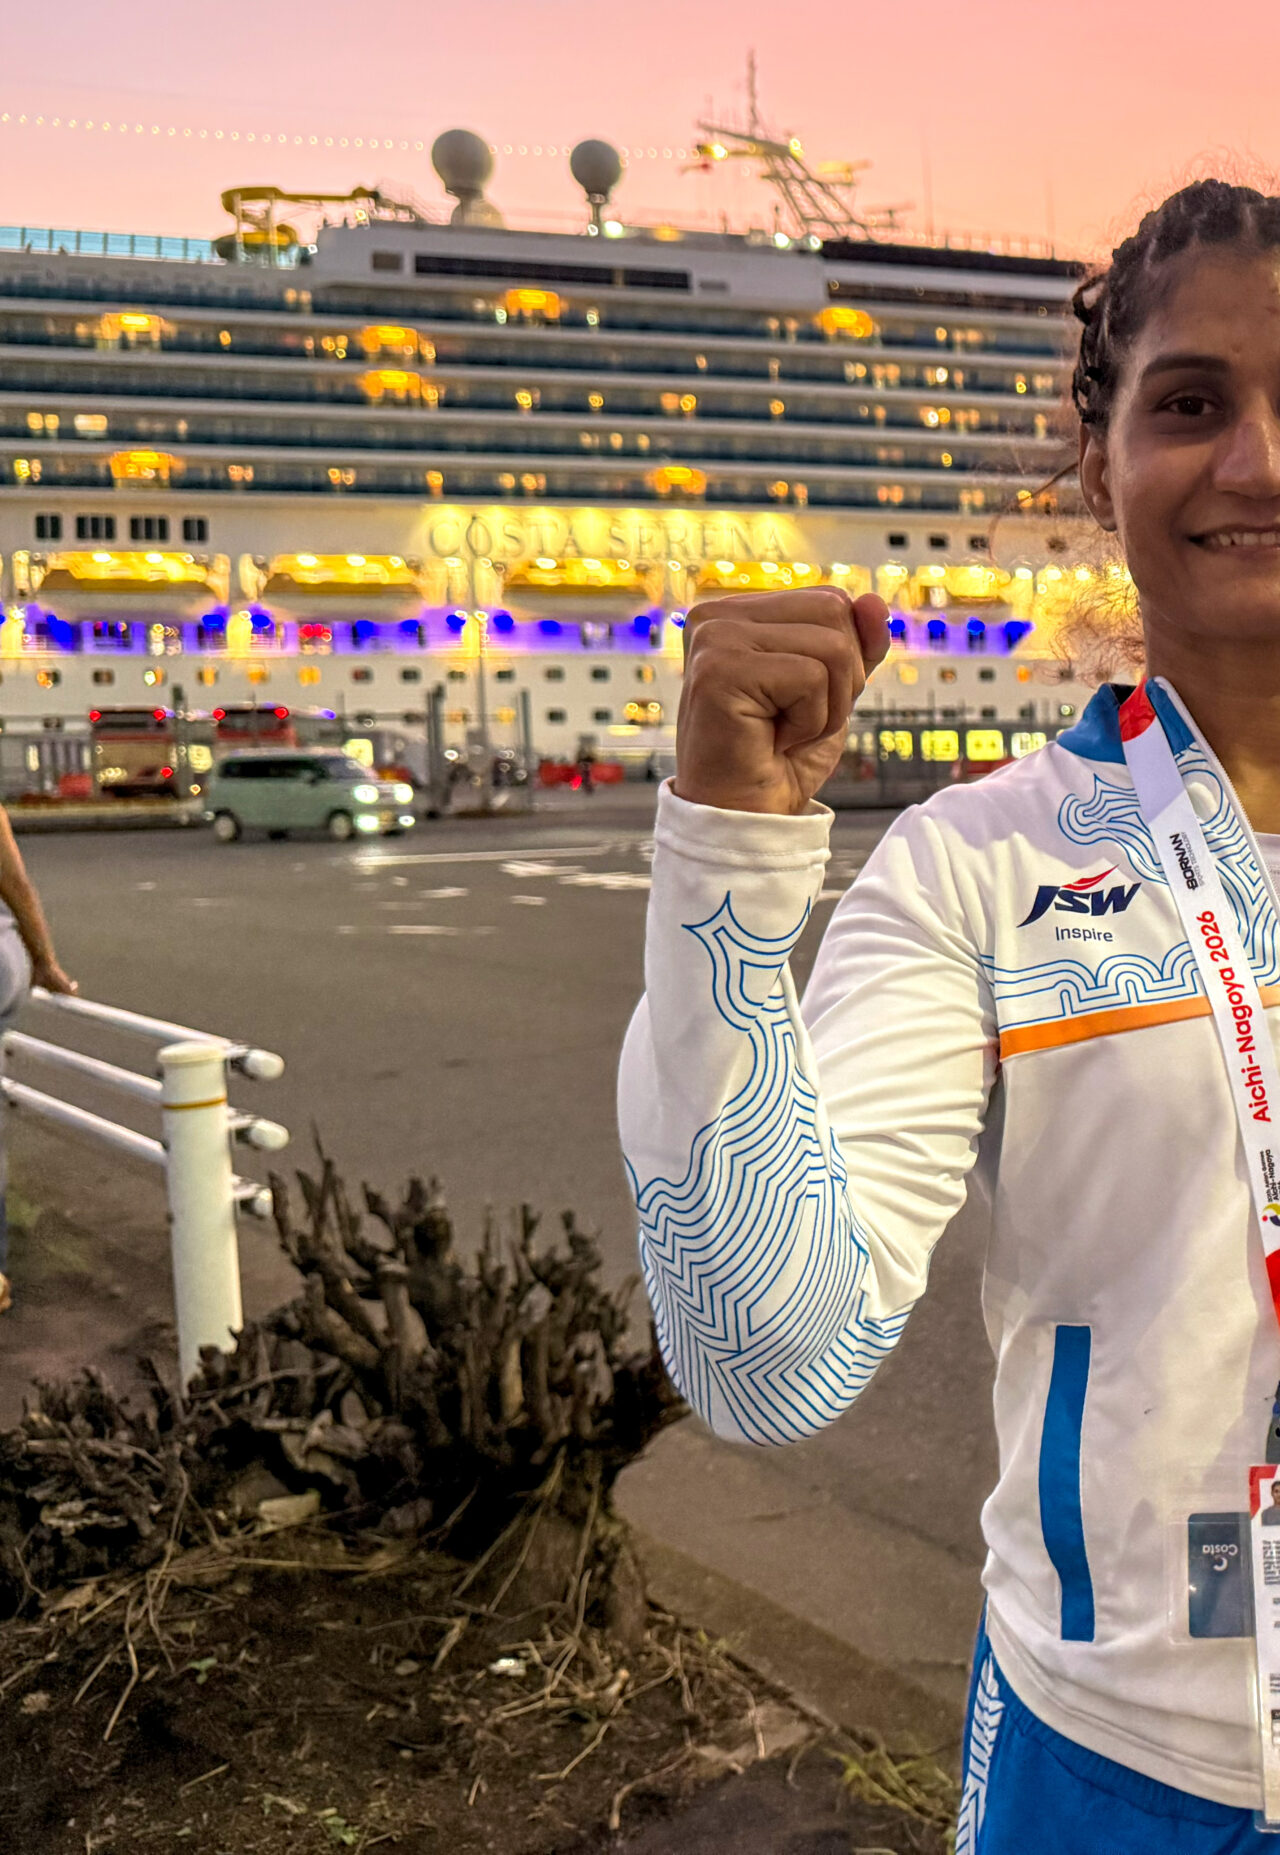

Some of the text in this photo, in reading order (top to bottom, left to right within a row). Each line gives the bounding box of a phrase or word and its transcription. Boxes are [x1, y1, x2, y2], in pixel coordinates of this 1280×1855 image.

[429, 518, 789, 561] COSTA SERENA
[1169, 832, 1199, 891] BORNAN
[1016, 882, 1142, 928] JSW
[1055, 926, 1114, 943] Inspire
[1196, 910, 1272, 1123] Aichi-Nagoya 2026
[1202, 1544, 1238, 1556] Costa
